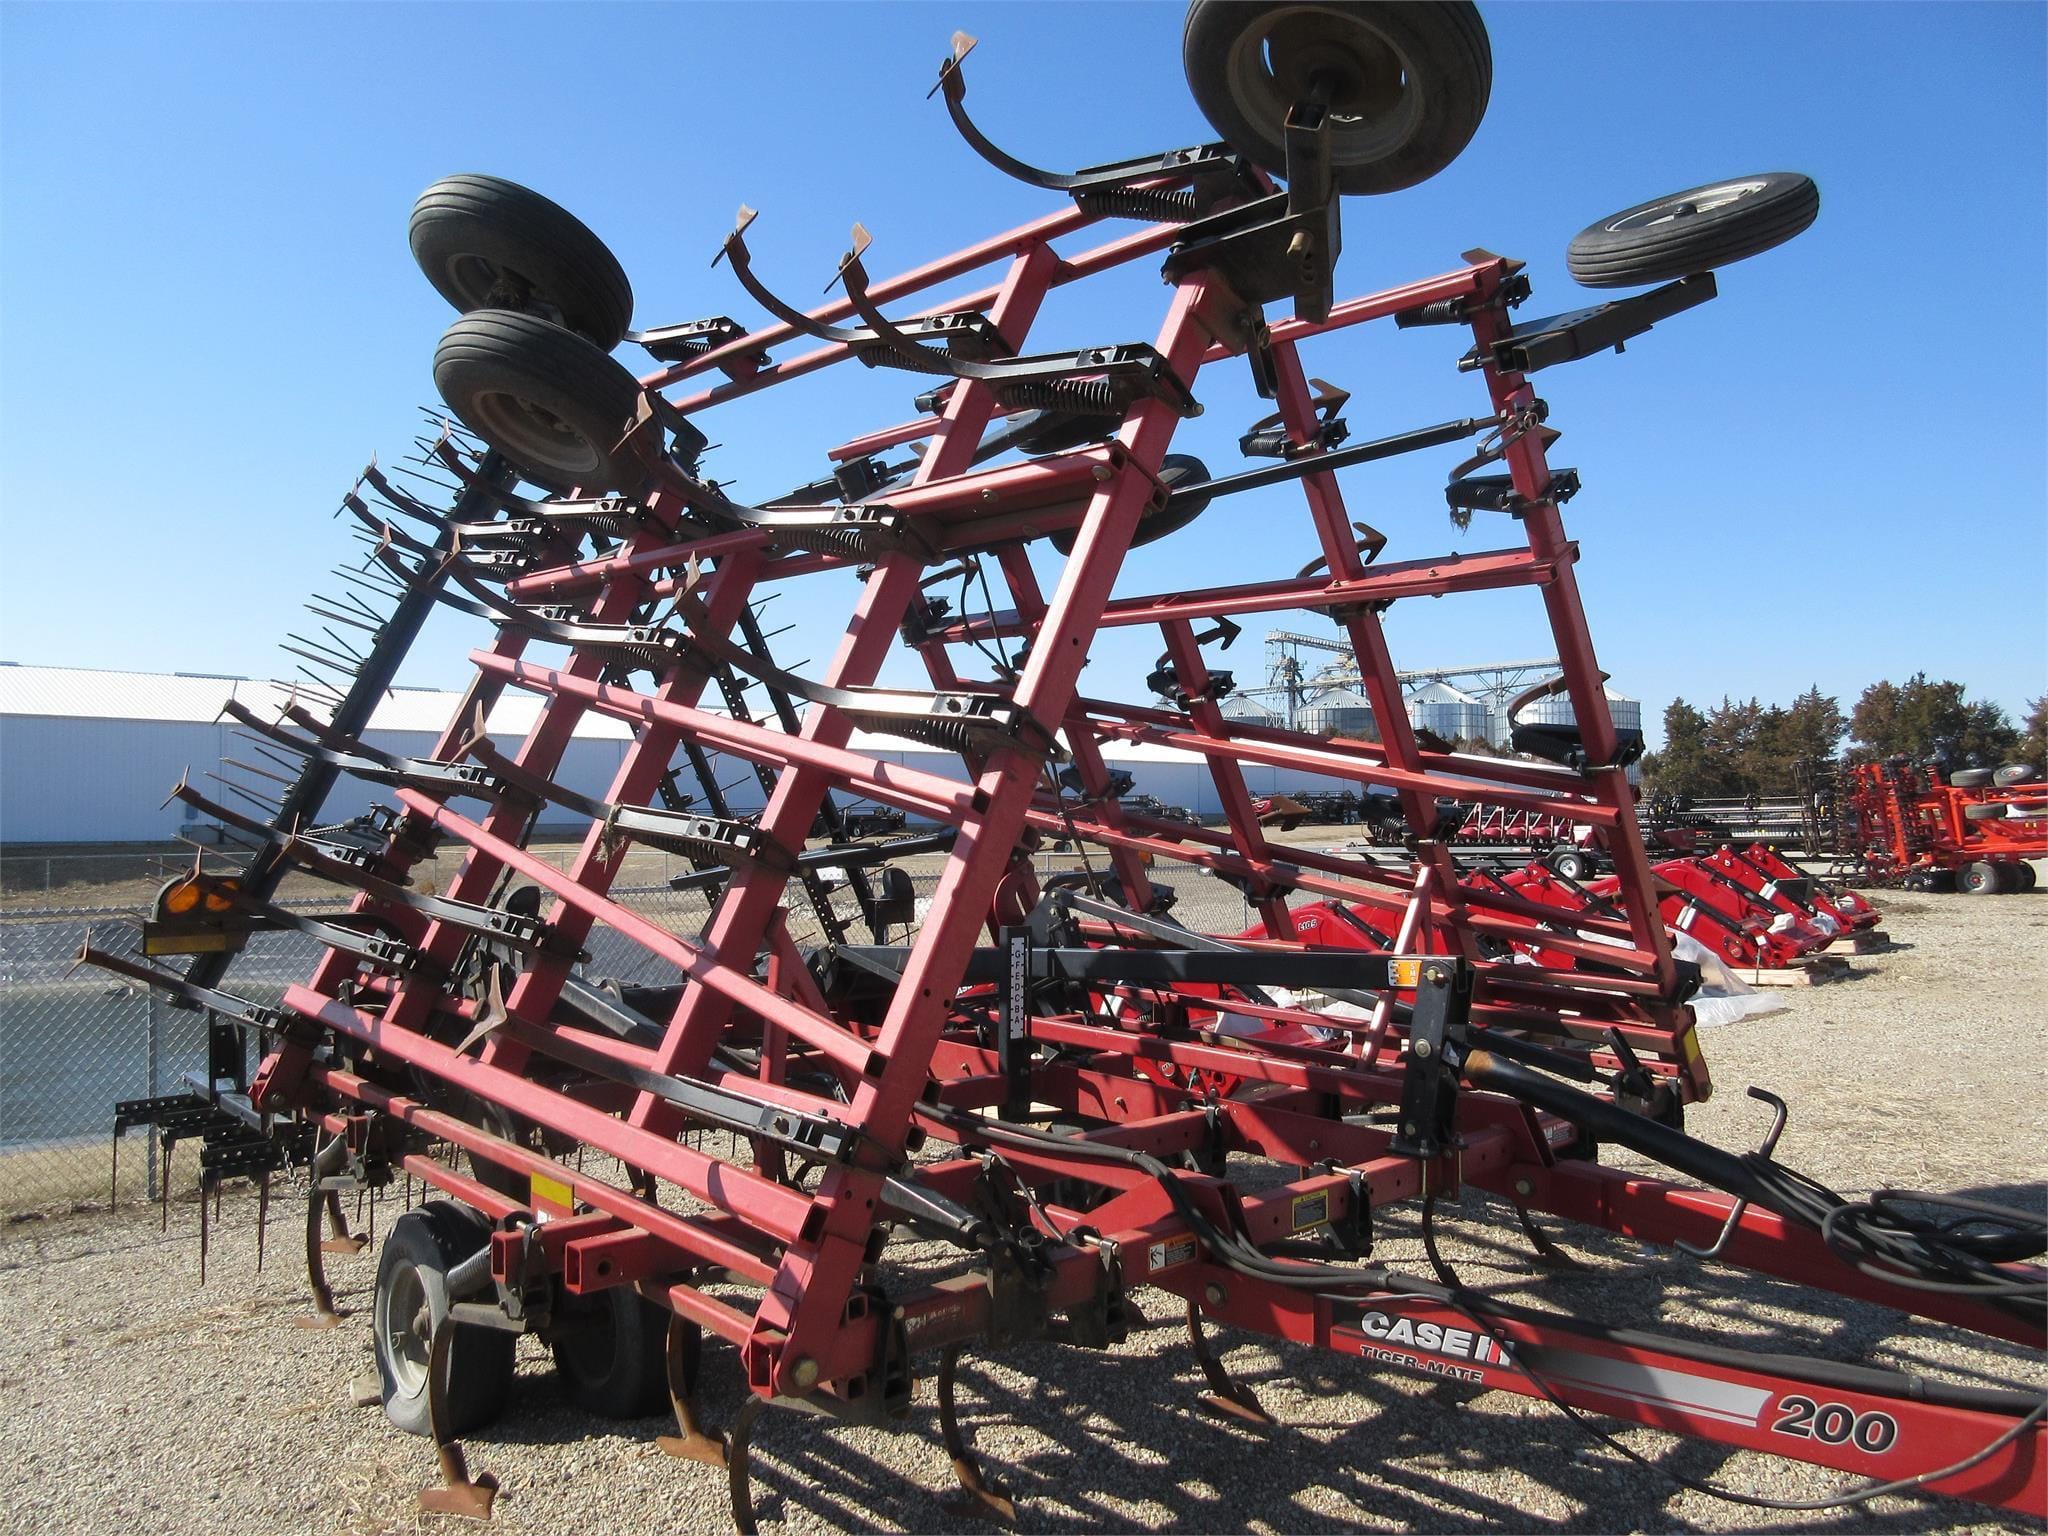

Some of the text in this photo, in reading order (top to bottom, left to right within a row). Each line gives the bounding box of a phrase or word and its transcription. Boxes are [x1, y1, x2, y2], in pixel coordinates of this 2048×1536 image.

[1361, 1311, 1473, 1357] CASE
[1360, 1344, 1484, 1384] TIGER-MATE
[1770, 1394, 1899, 1454] 200
